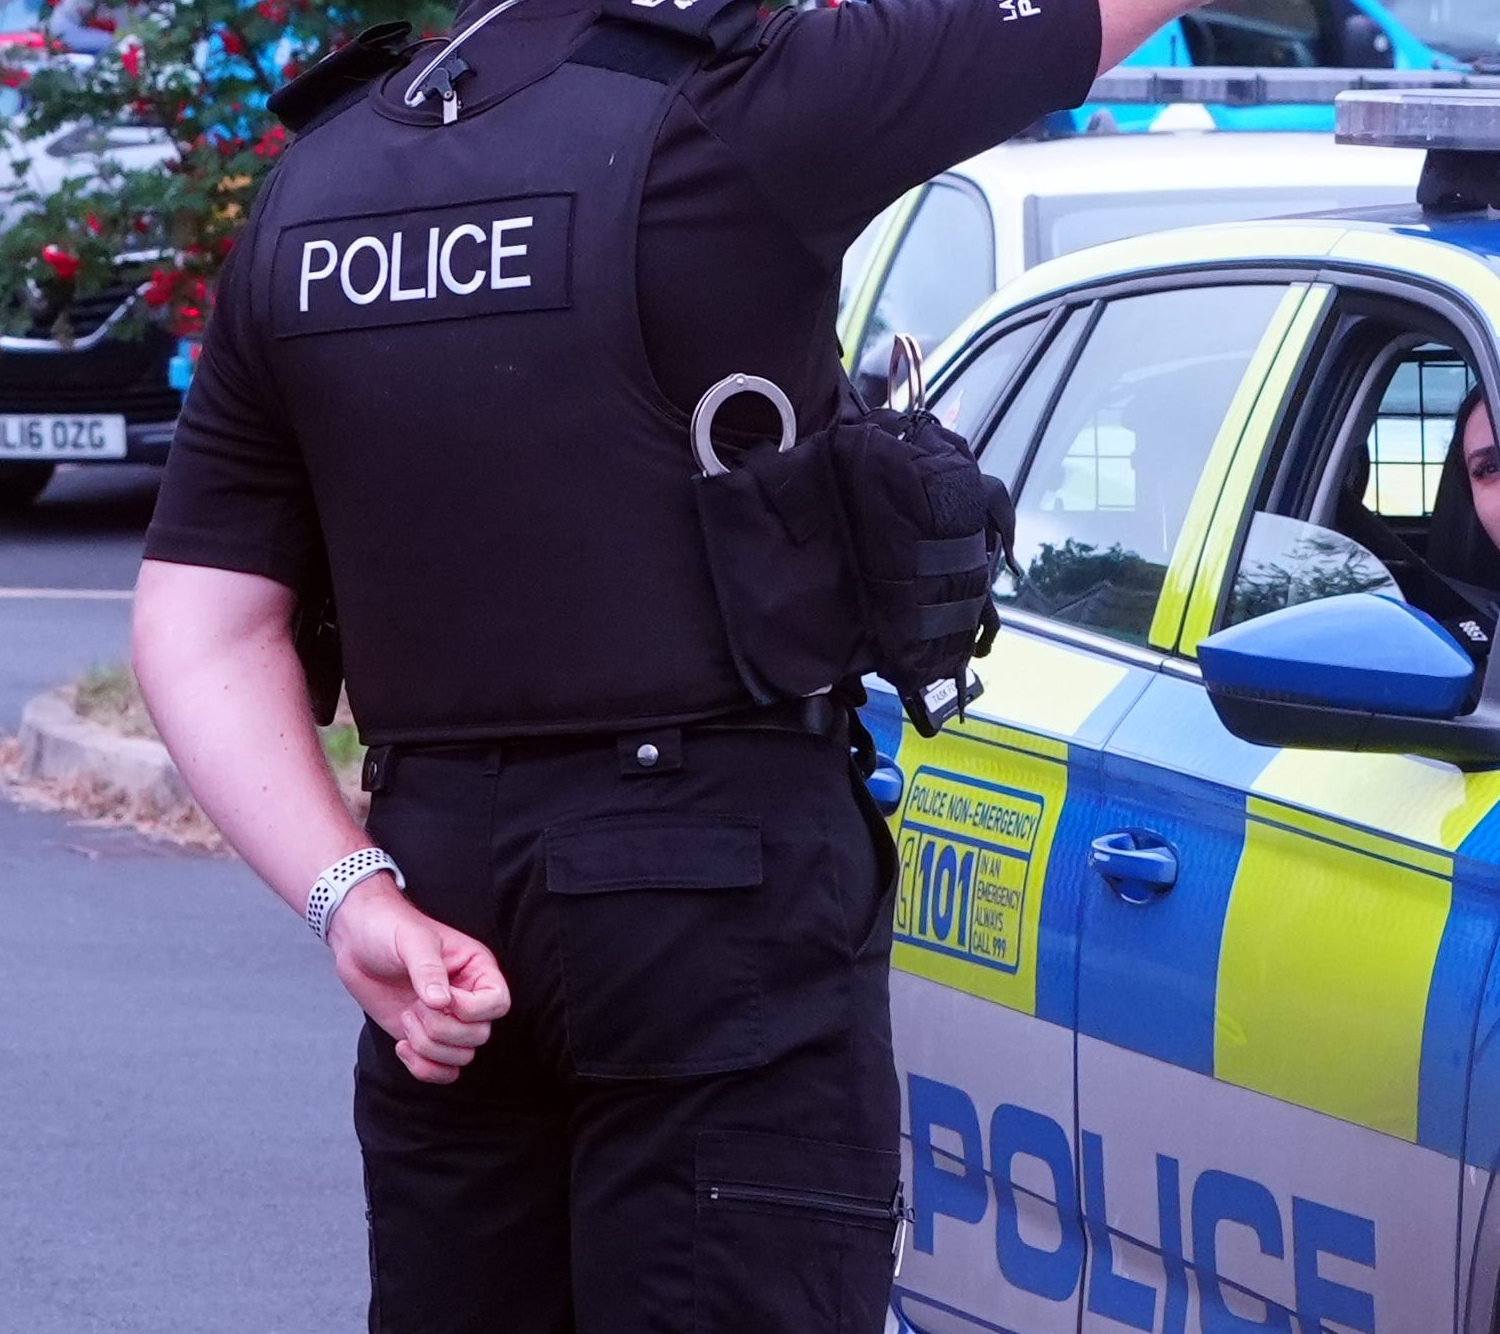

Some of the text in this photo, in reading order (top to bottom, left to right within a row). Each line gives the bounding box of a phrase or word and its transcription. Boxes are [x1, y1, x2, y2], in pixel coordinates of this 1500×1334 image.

[300, 216, 533, 312] POLICE
[909, 785, 1037, 842] POLICE NON-EMERGENCY
[980, 853, 1002, 878] IN AN
[918, 840, 975, 947] 101
[977, 880, 1021, 910] EMERGENCY
[974, 906, 1004, 932] ALWAYS
[973, 931, 1007, 958] CALL 999
